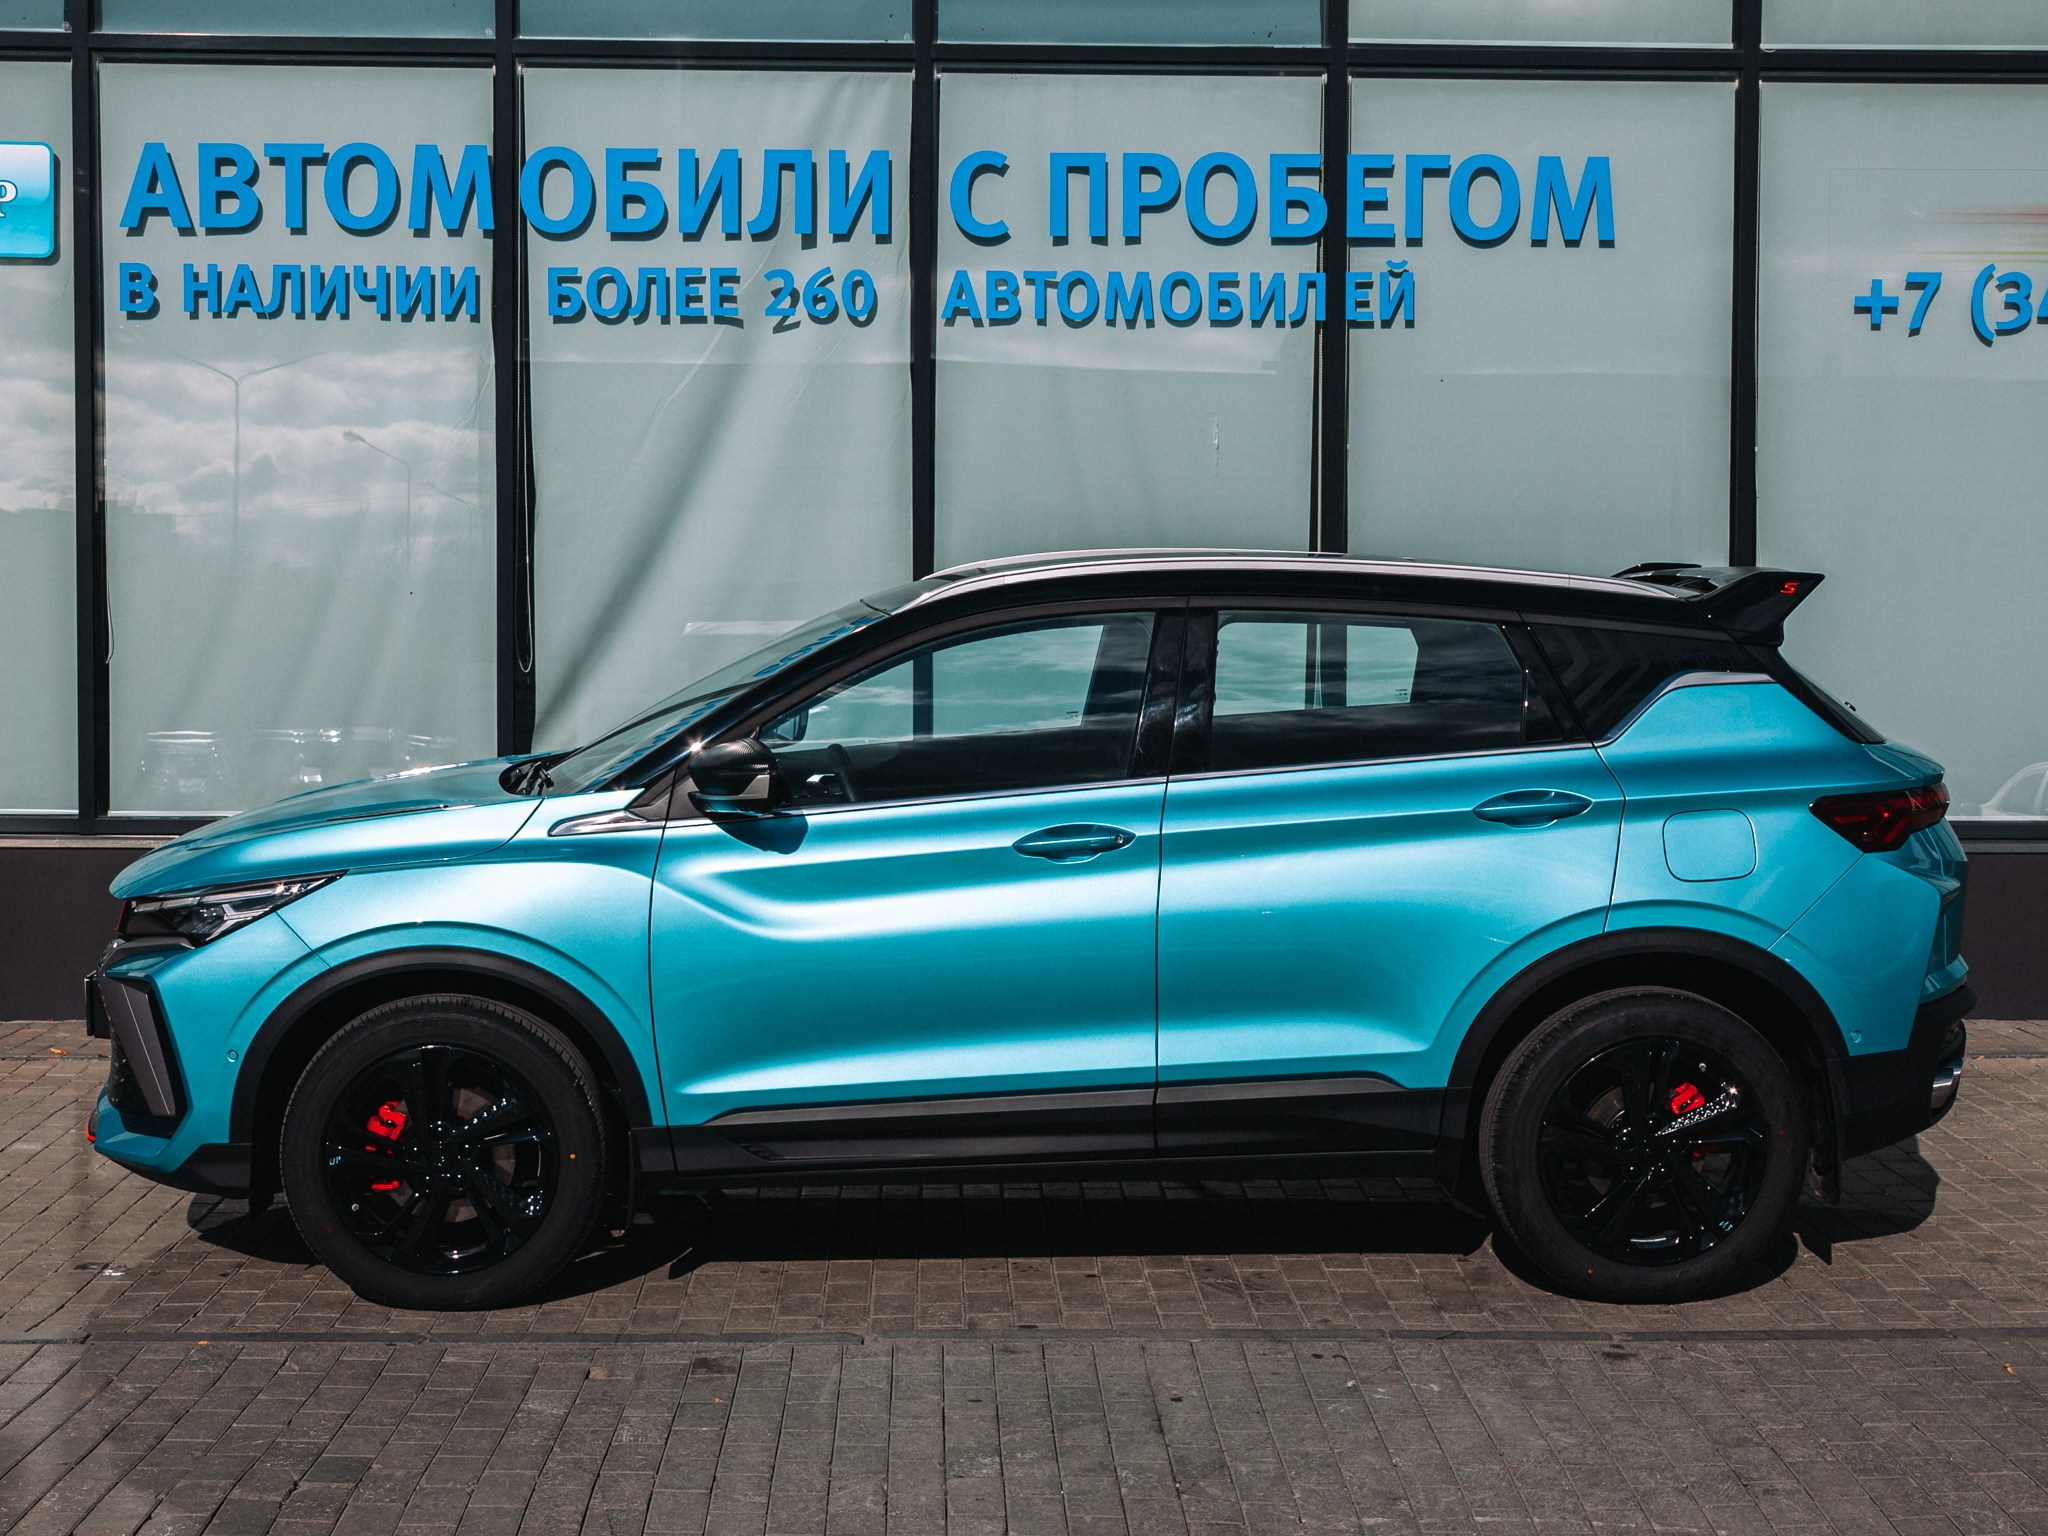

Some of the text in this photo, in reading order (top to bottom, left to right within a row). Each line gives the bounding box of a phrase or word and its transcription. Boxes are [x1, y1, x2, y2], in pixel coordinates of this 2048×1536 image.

[120, 142, 1615, 240] АВТОМОБИЛИ С ПРОБЕГОМ
[120, 260, 1414, 321] В НАЛИЧИИ БОЛЕЕ 260 АВТОМОБИЛЕЙ
[1854, 264, 2048, 340] +7 (3
[1780, 581, 1800, 594] S
